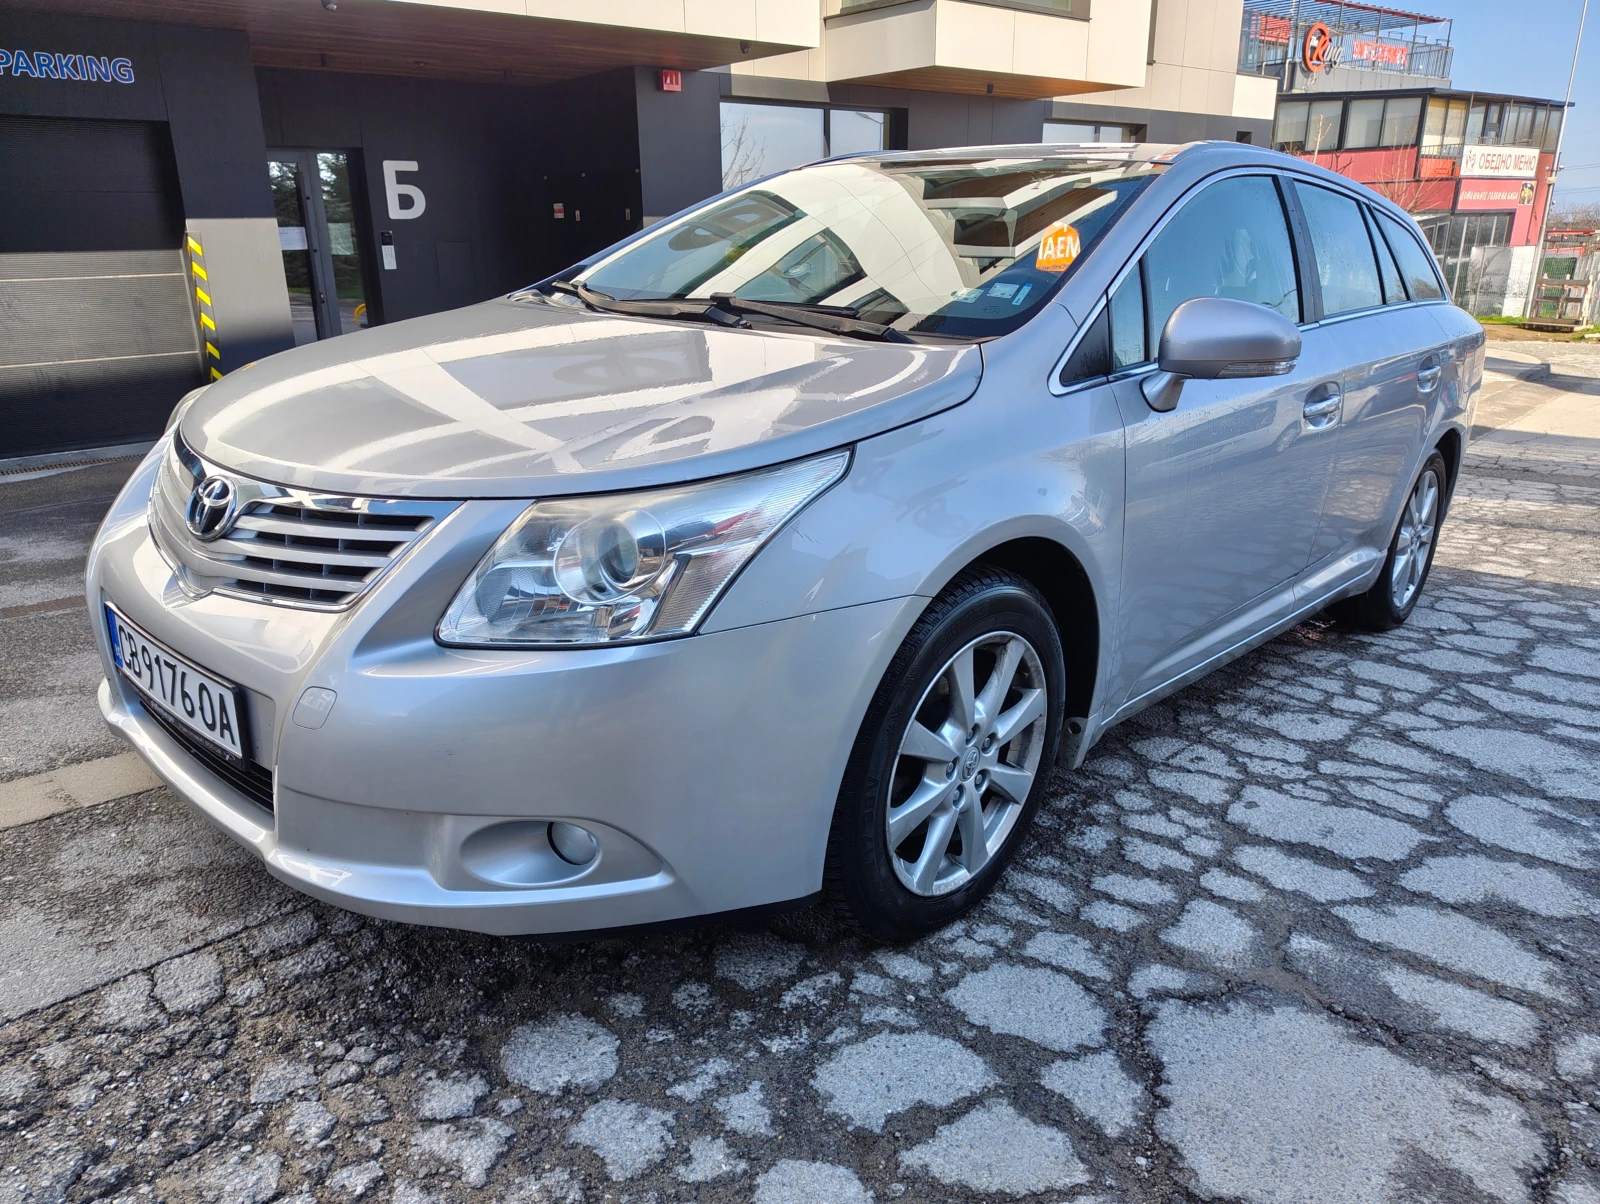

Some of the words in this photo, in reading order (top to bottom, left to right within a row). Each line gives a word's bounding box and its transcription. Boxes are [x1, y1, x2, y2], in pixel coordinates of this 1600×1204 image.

[0, 49, 135, 84] PARKING
[1478, 153, 1512, 173] ОБЕДНО
[1513, 154, 1537, 171] МЕНЮ
[382, 160, 426, 220] Б
